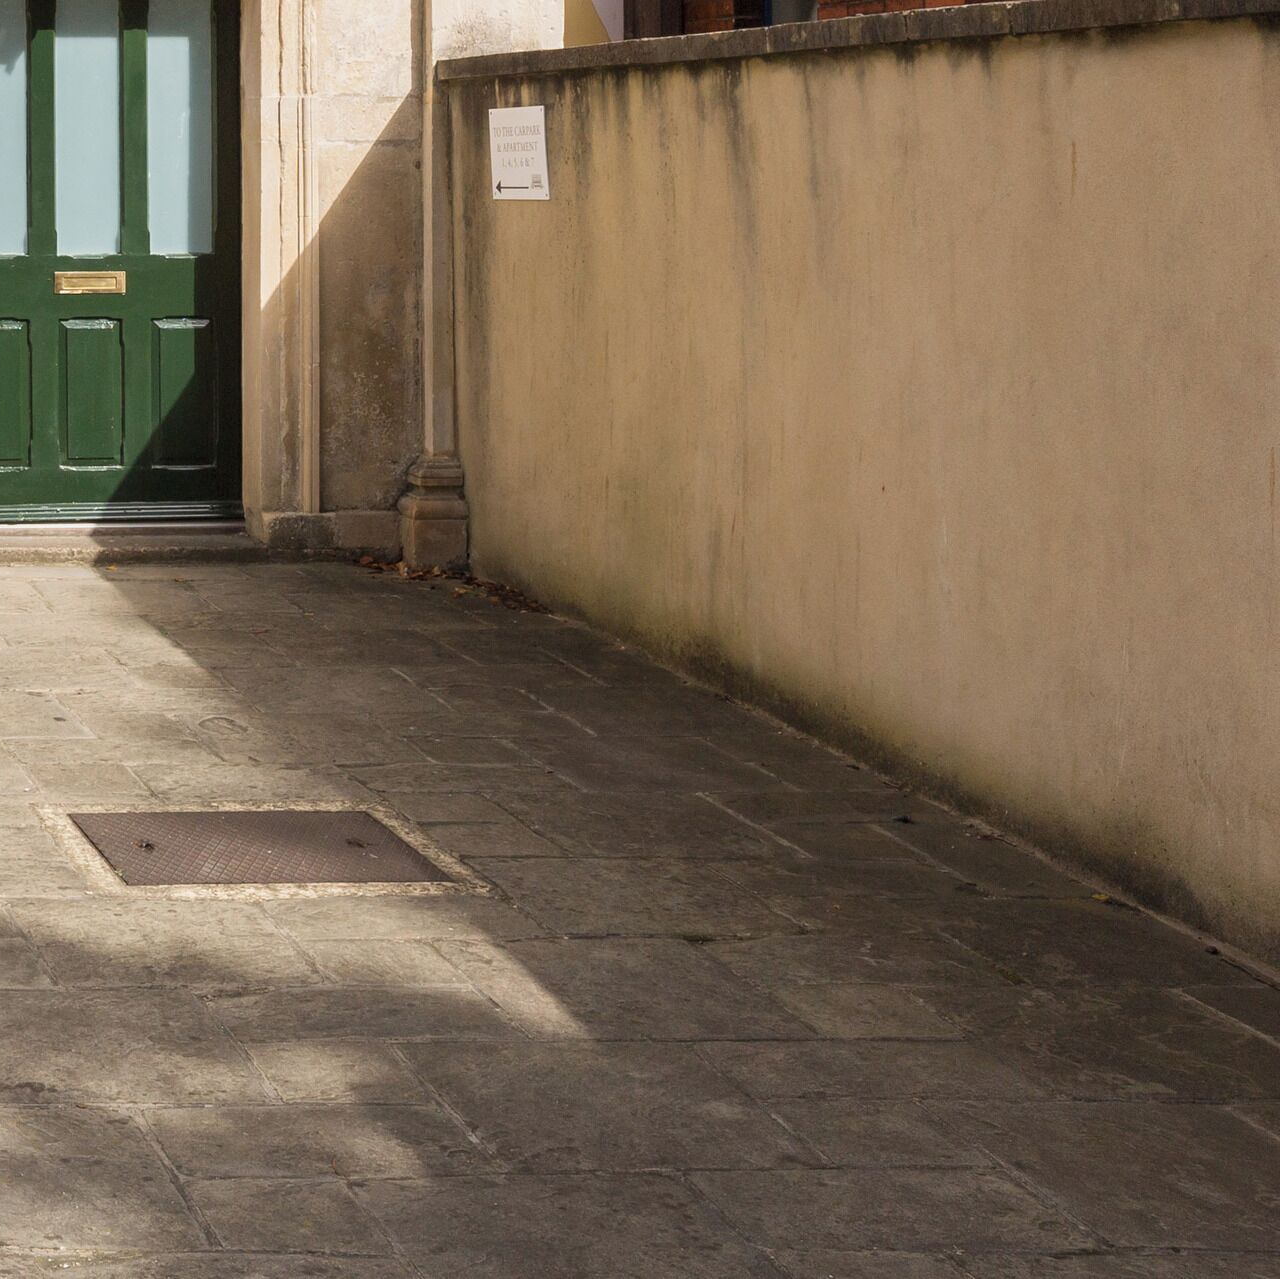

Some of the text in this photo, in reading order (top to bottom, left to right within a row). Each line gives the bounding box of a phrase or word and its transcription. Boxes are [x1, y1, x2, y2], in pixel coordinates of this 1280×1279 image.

[493, 125, 541, 137] TO THE CARPARK
[503, 141, 538, 152] APARTMENT
